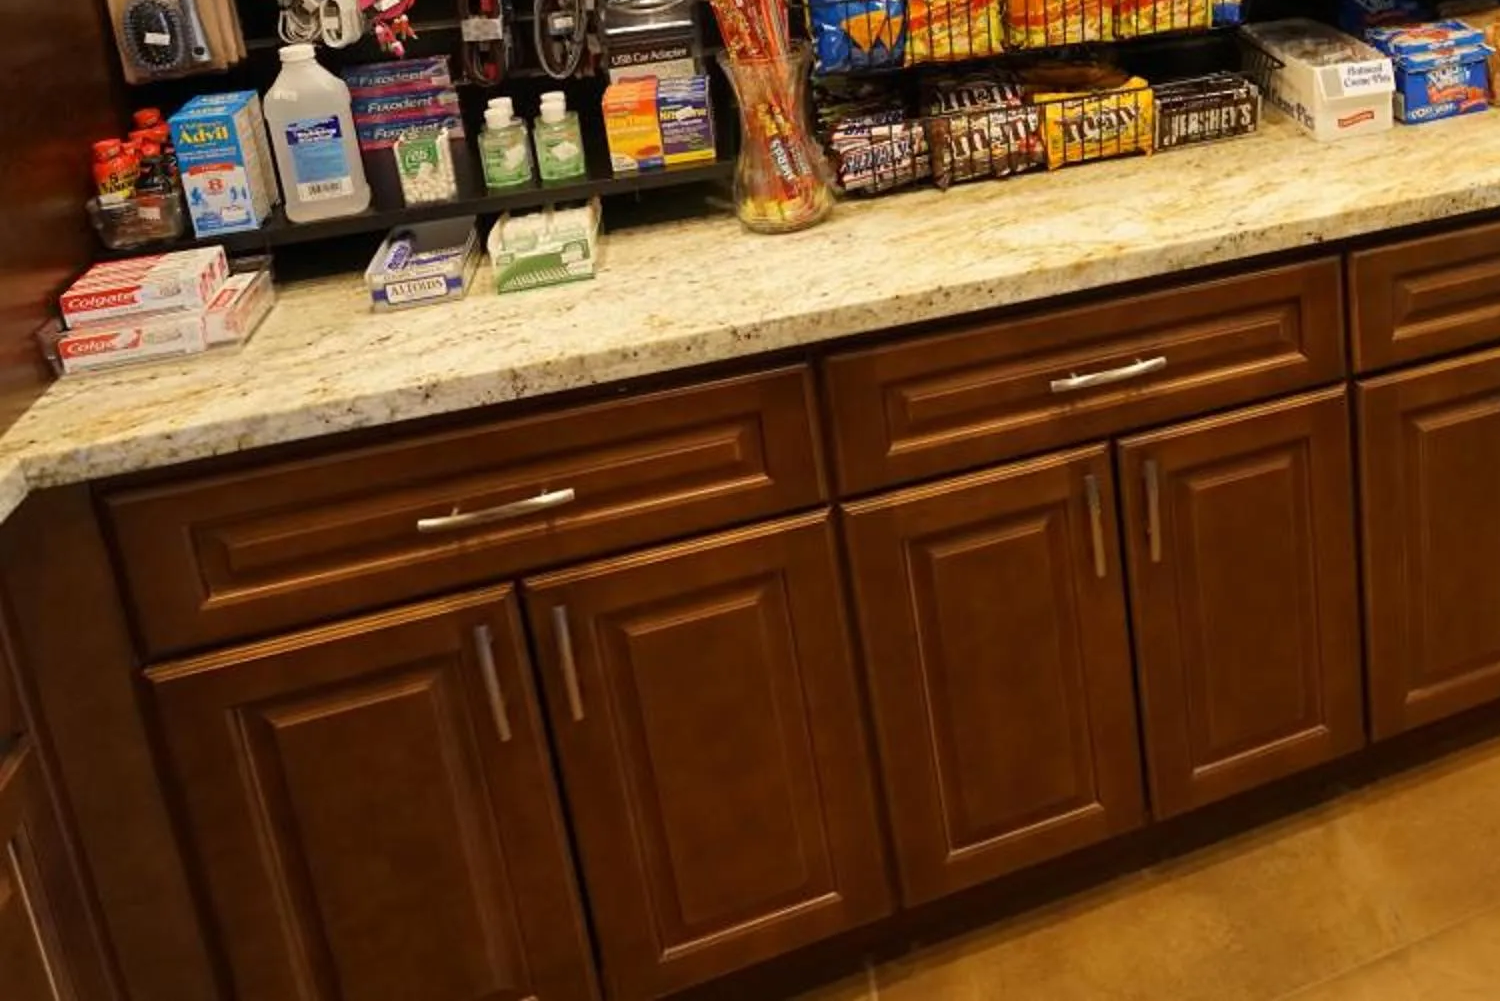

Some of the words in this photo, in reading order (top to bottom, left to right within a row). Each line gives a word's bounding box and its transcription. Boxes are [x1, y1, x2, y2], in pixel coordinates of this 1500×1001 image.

[611, 53, 633, 66] USB
[633, 52, 649, 63] Car
[650, 47, 688, 61] Adapter
[367, 96, 433, 114] Fixodent
[179, 123, 229, 146] Advil
